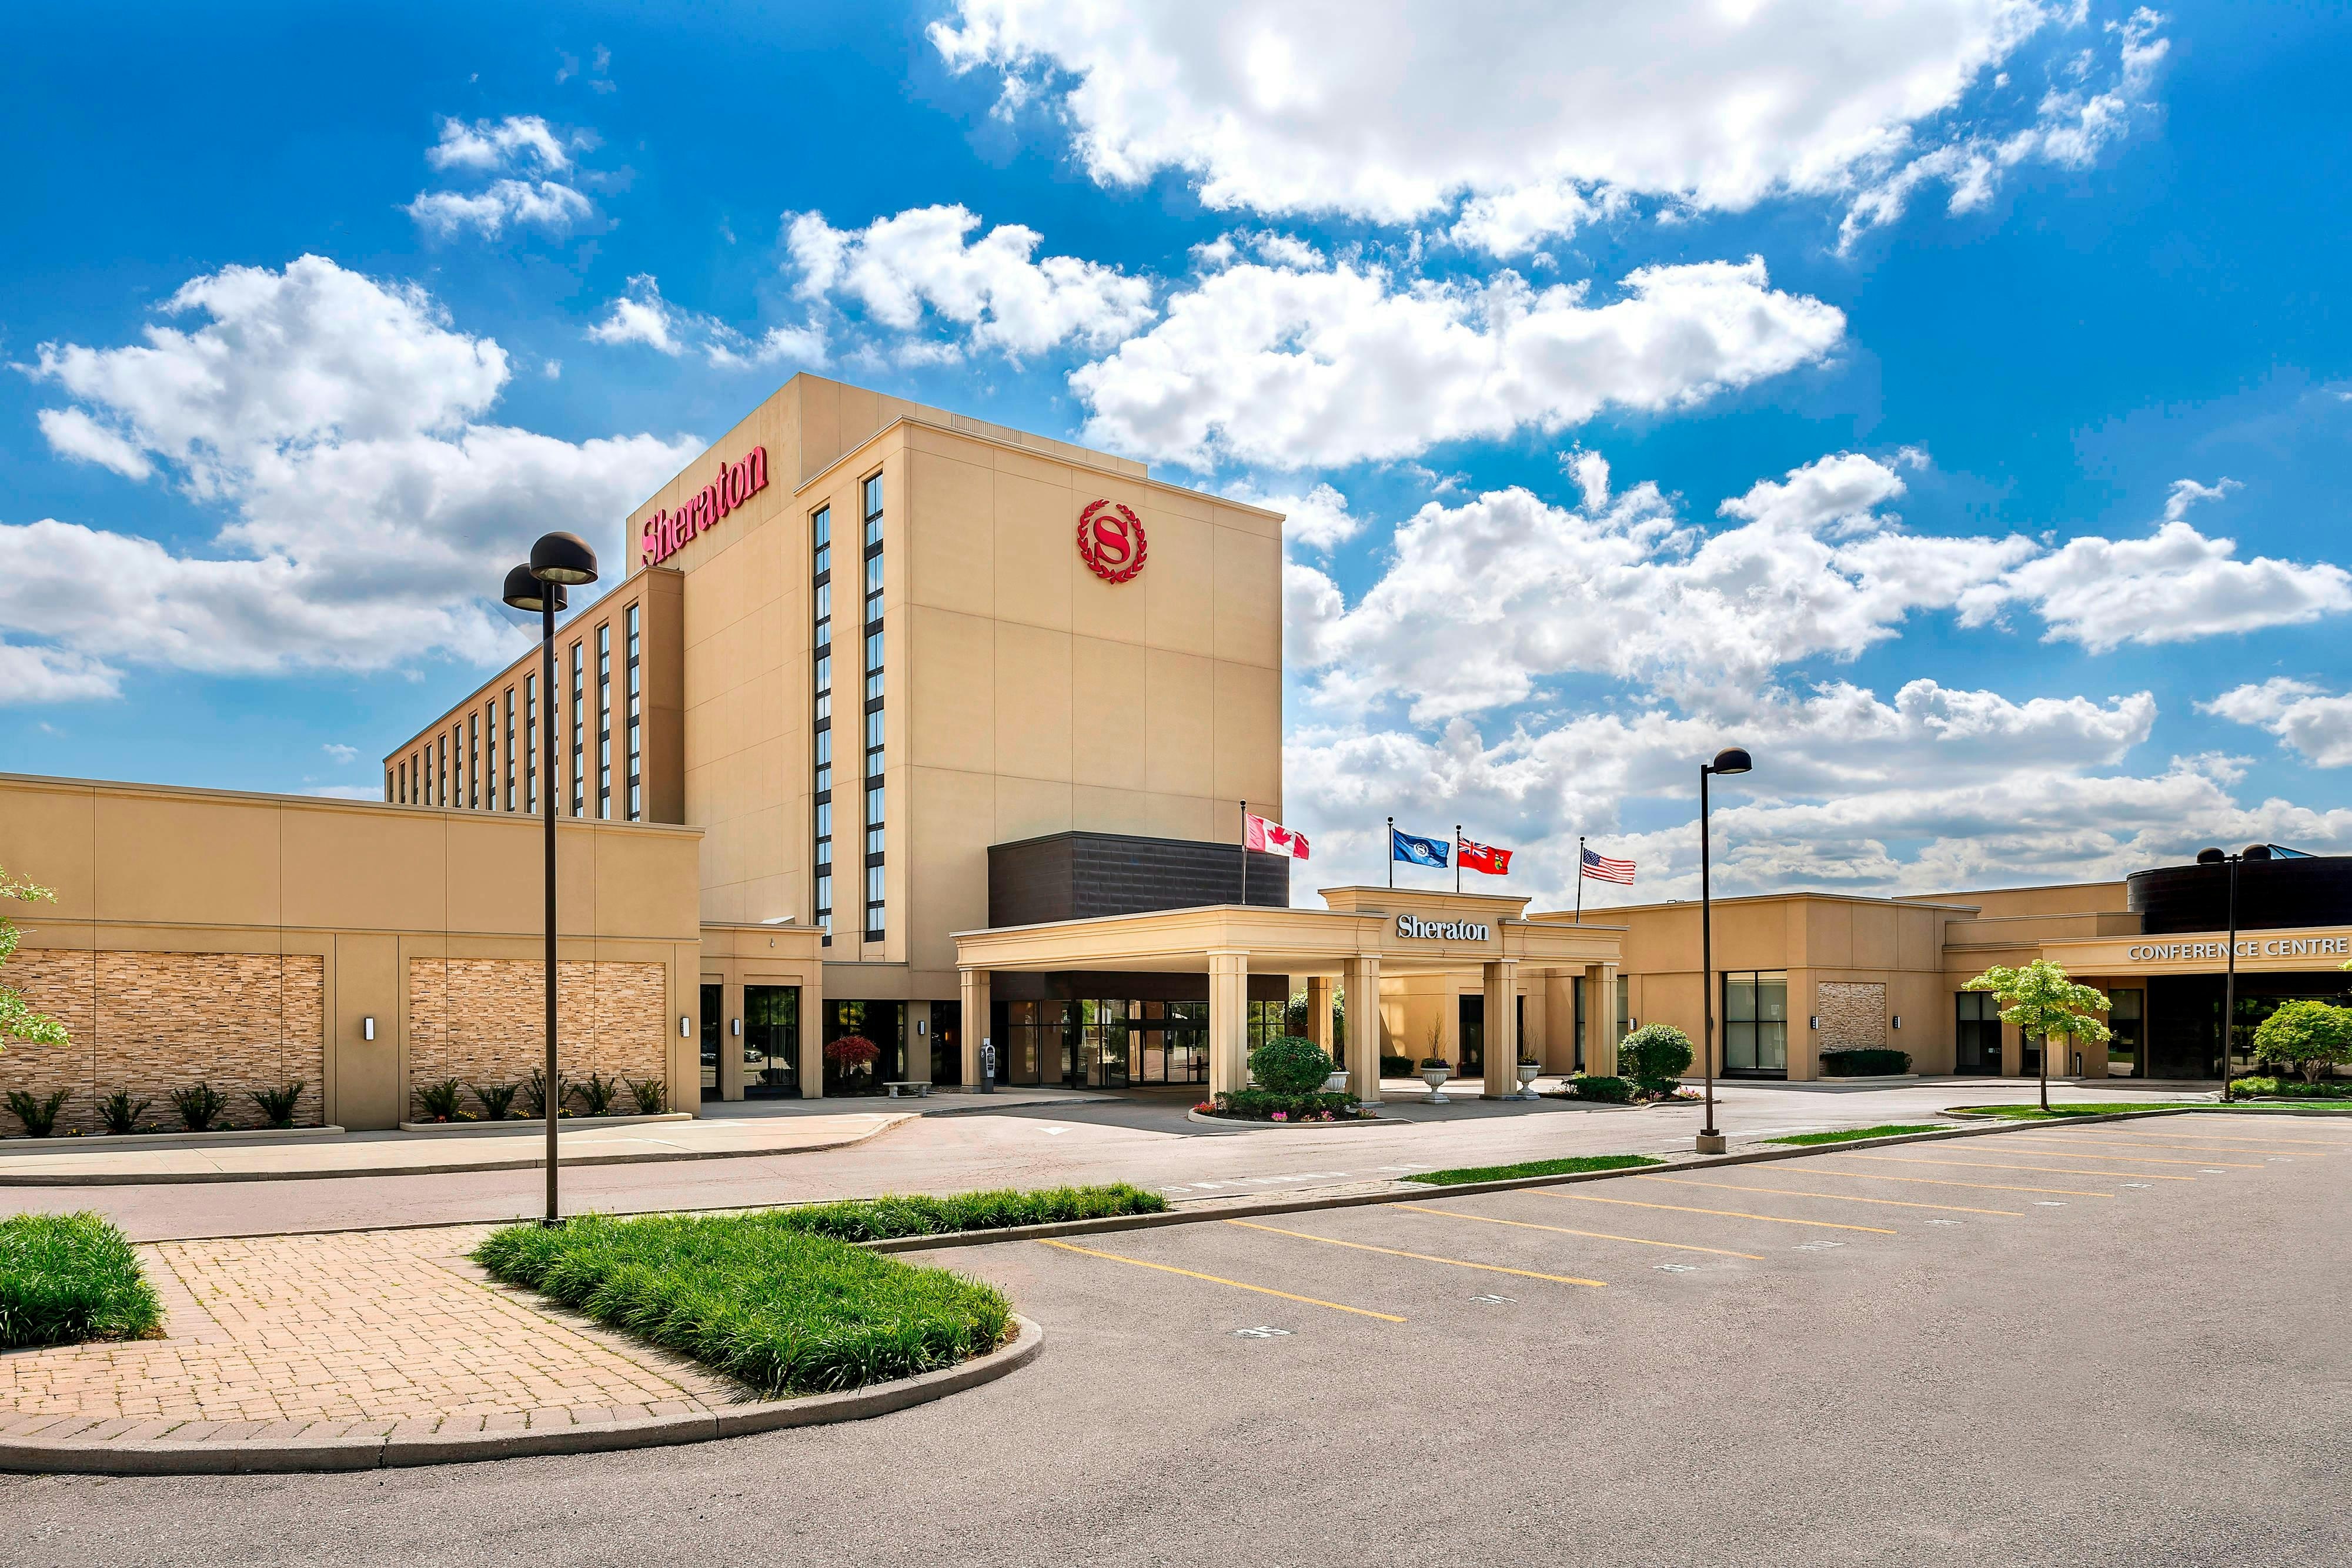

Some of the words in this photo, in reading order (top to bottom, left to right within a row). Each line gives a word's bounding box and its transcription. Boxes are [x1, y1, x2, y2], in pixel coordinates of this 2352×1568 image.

[642, 446, 769, 566] Sheraton
[1093, 516, 1130, 564] S
[1396, 914, 1489, 941] Sheraton
[2127, 942, 2259, 960] CONFERENCE
[2264, 937, 2348, 955] CENTRE
